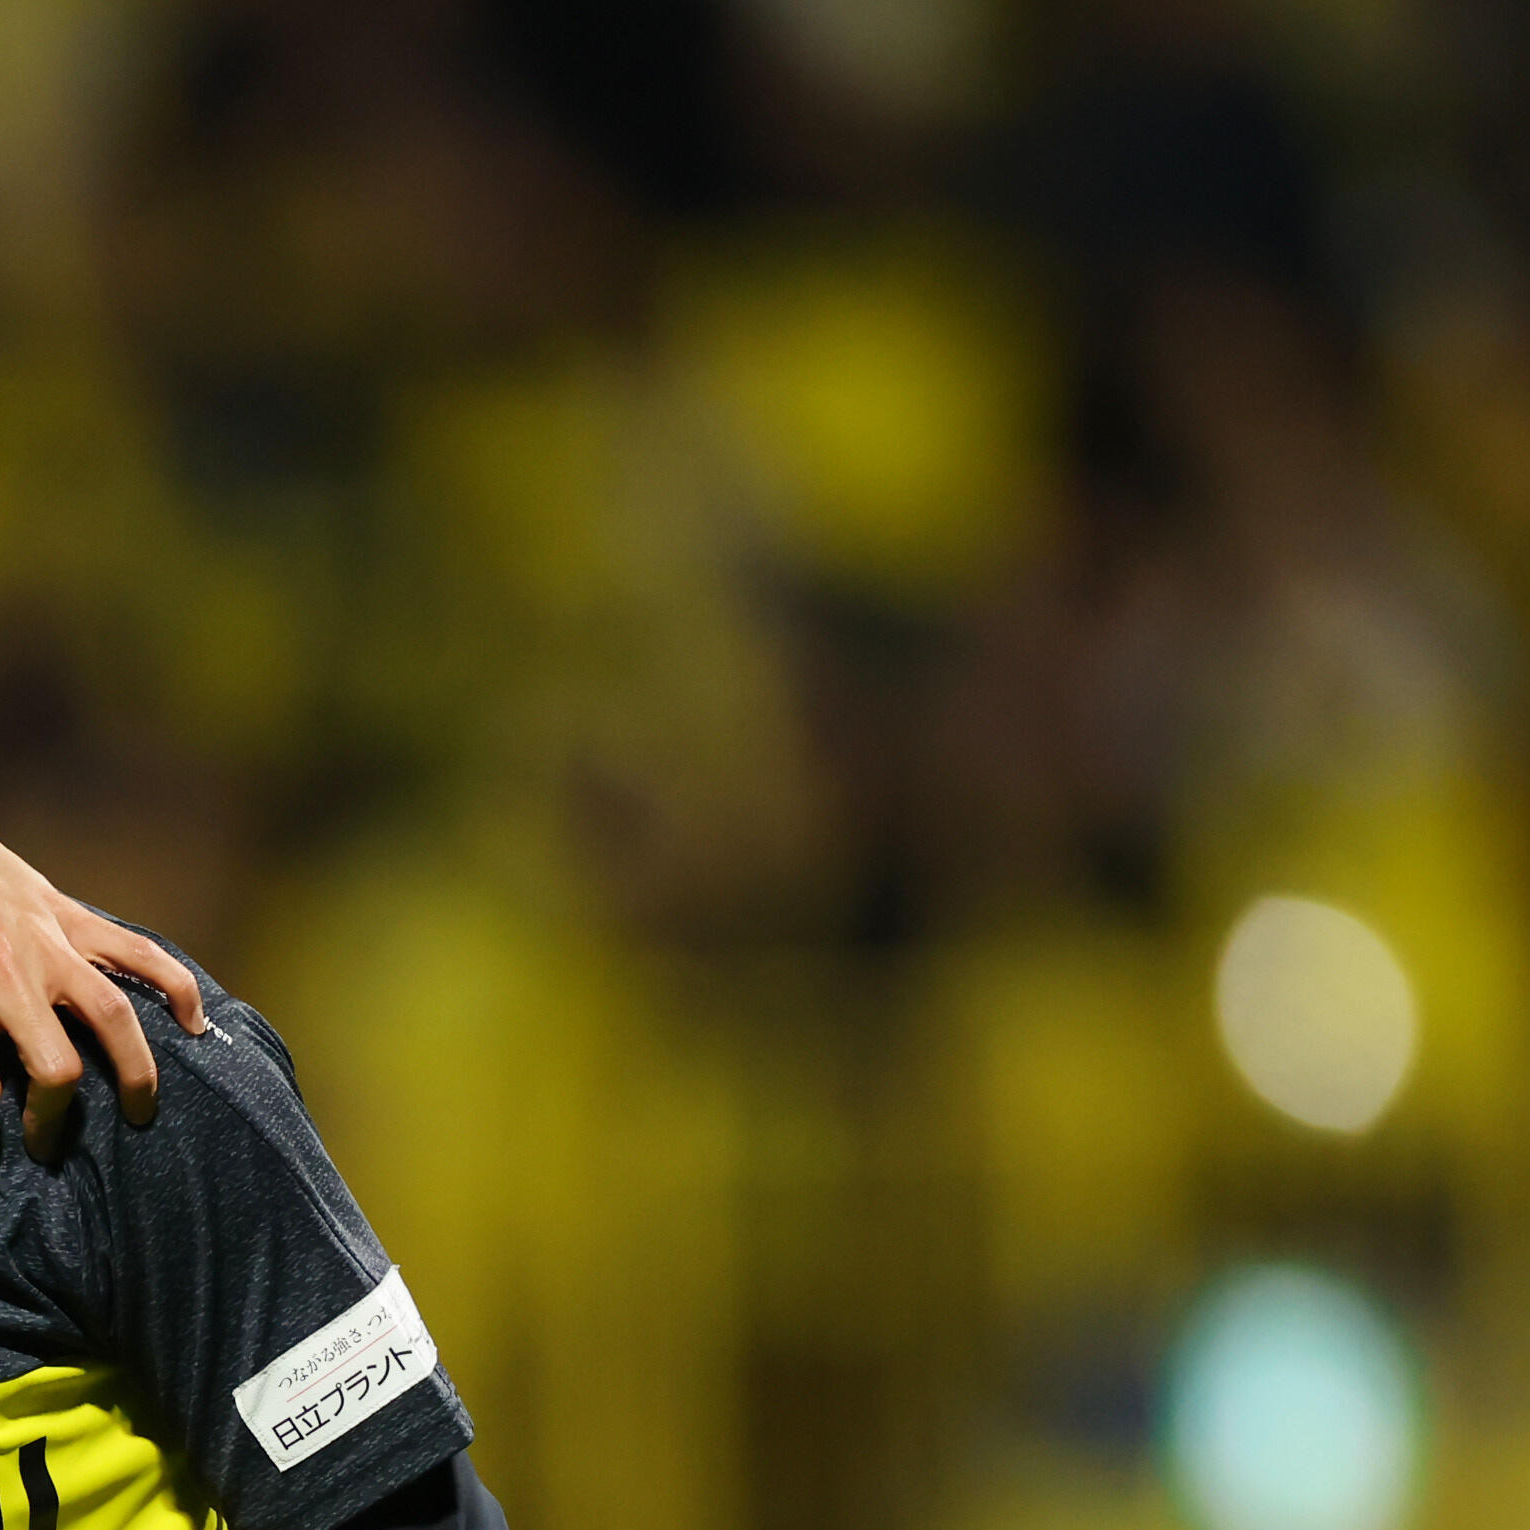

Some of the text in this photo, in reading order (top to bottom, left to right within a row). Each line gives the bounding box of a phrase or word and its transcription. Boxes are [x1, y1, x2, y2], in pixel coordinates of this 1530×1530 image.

[271, 1347, 413, 1450] 日立プラント
